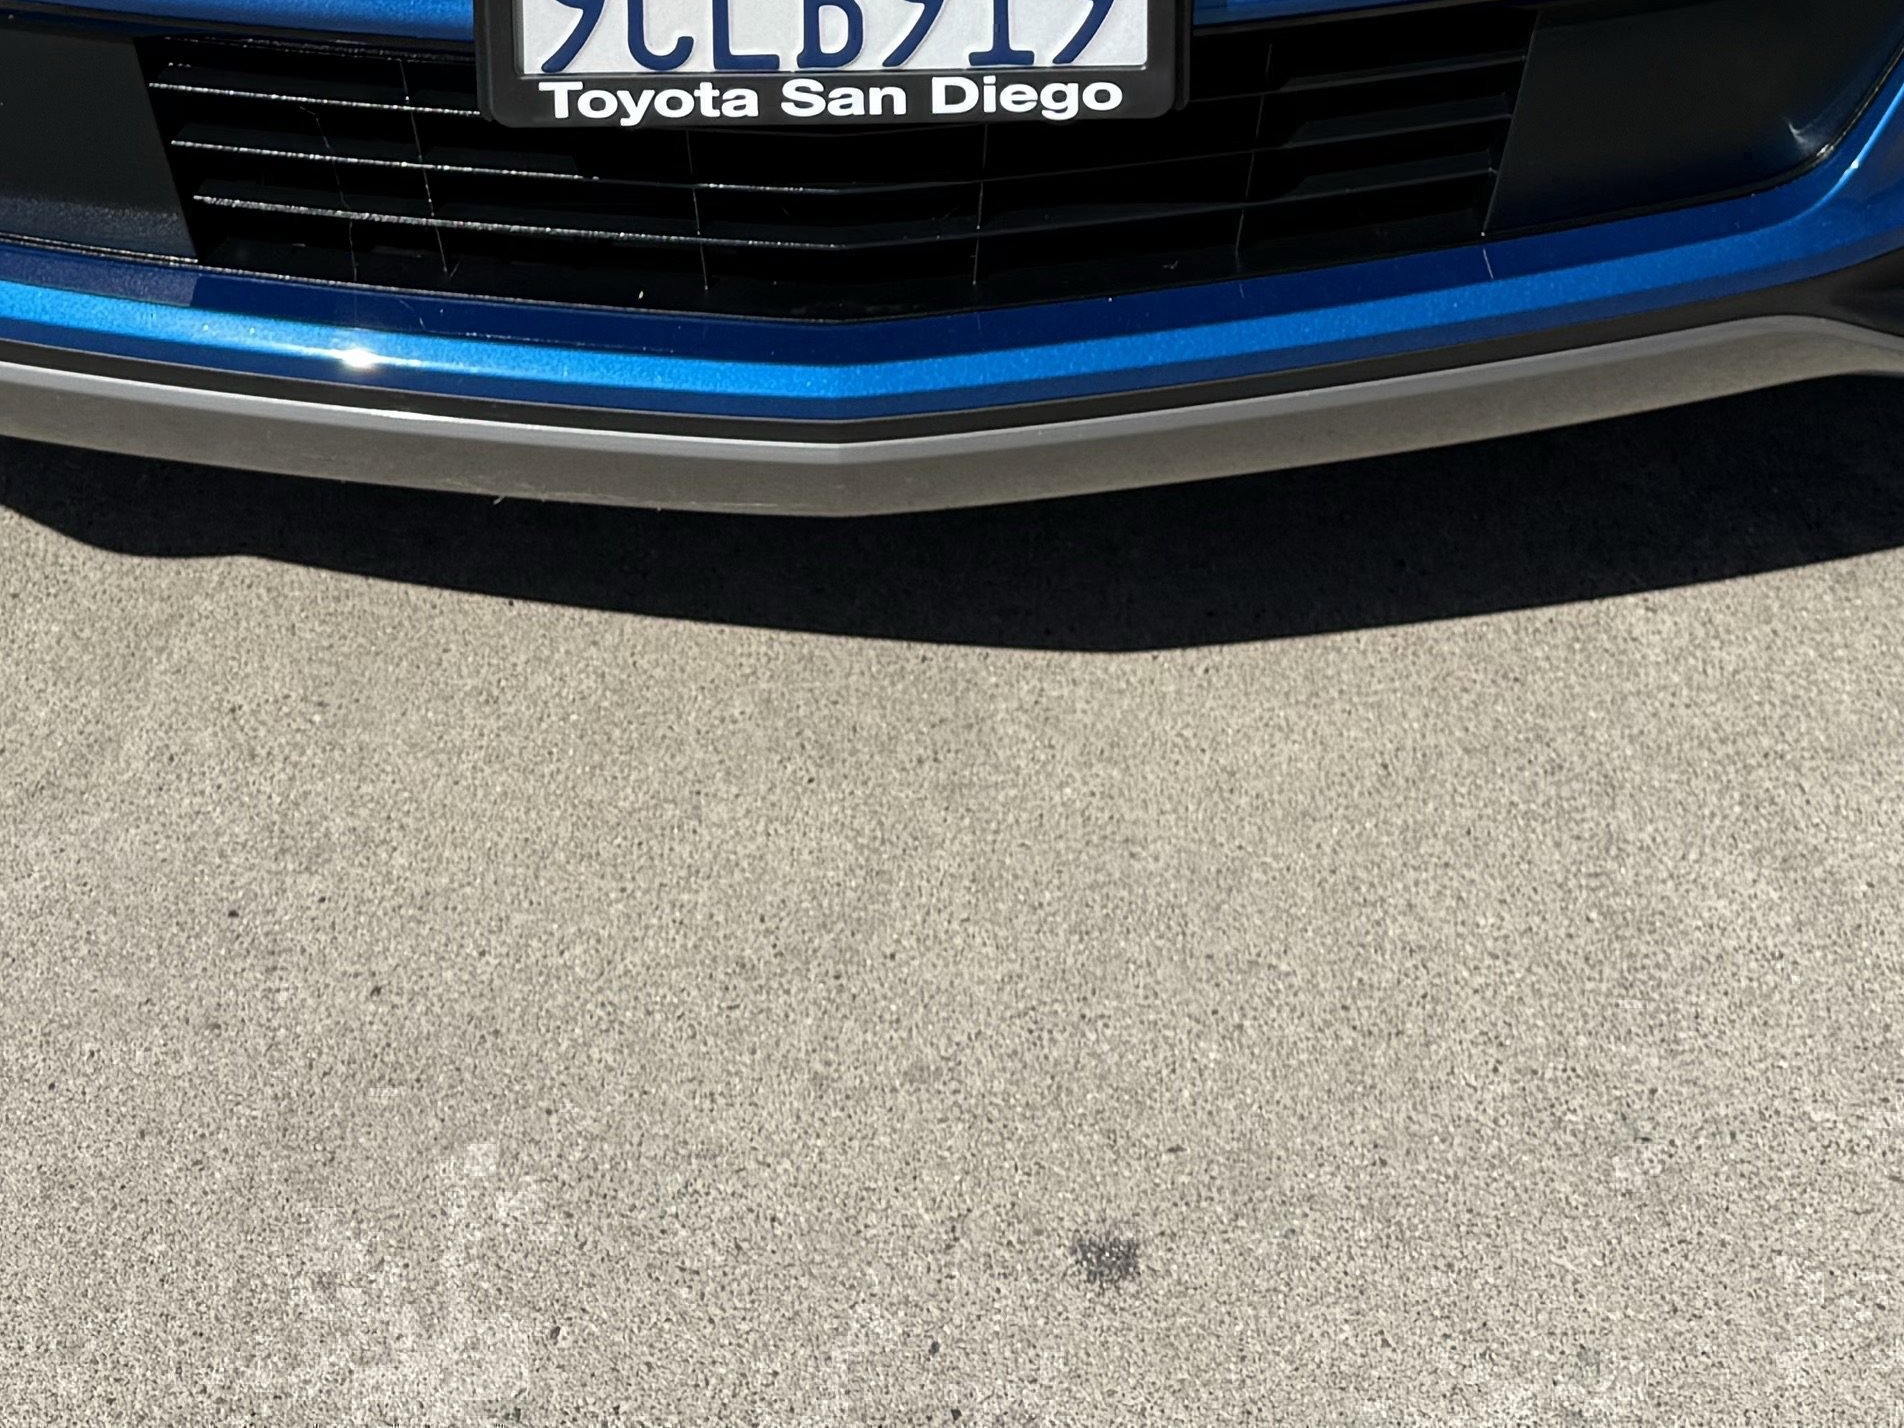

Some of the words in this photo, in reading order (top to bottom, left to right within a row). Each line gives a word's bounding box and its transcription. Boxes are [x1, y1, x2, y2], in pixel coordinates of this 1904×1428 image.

[538, 81, 759, 127] Toyota
[781, 77, 907, 118] San
[931, 75, 1124, 121] Diego
